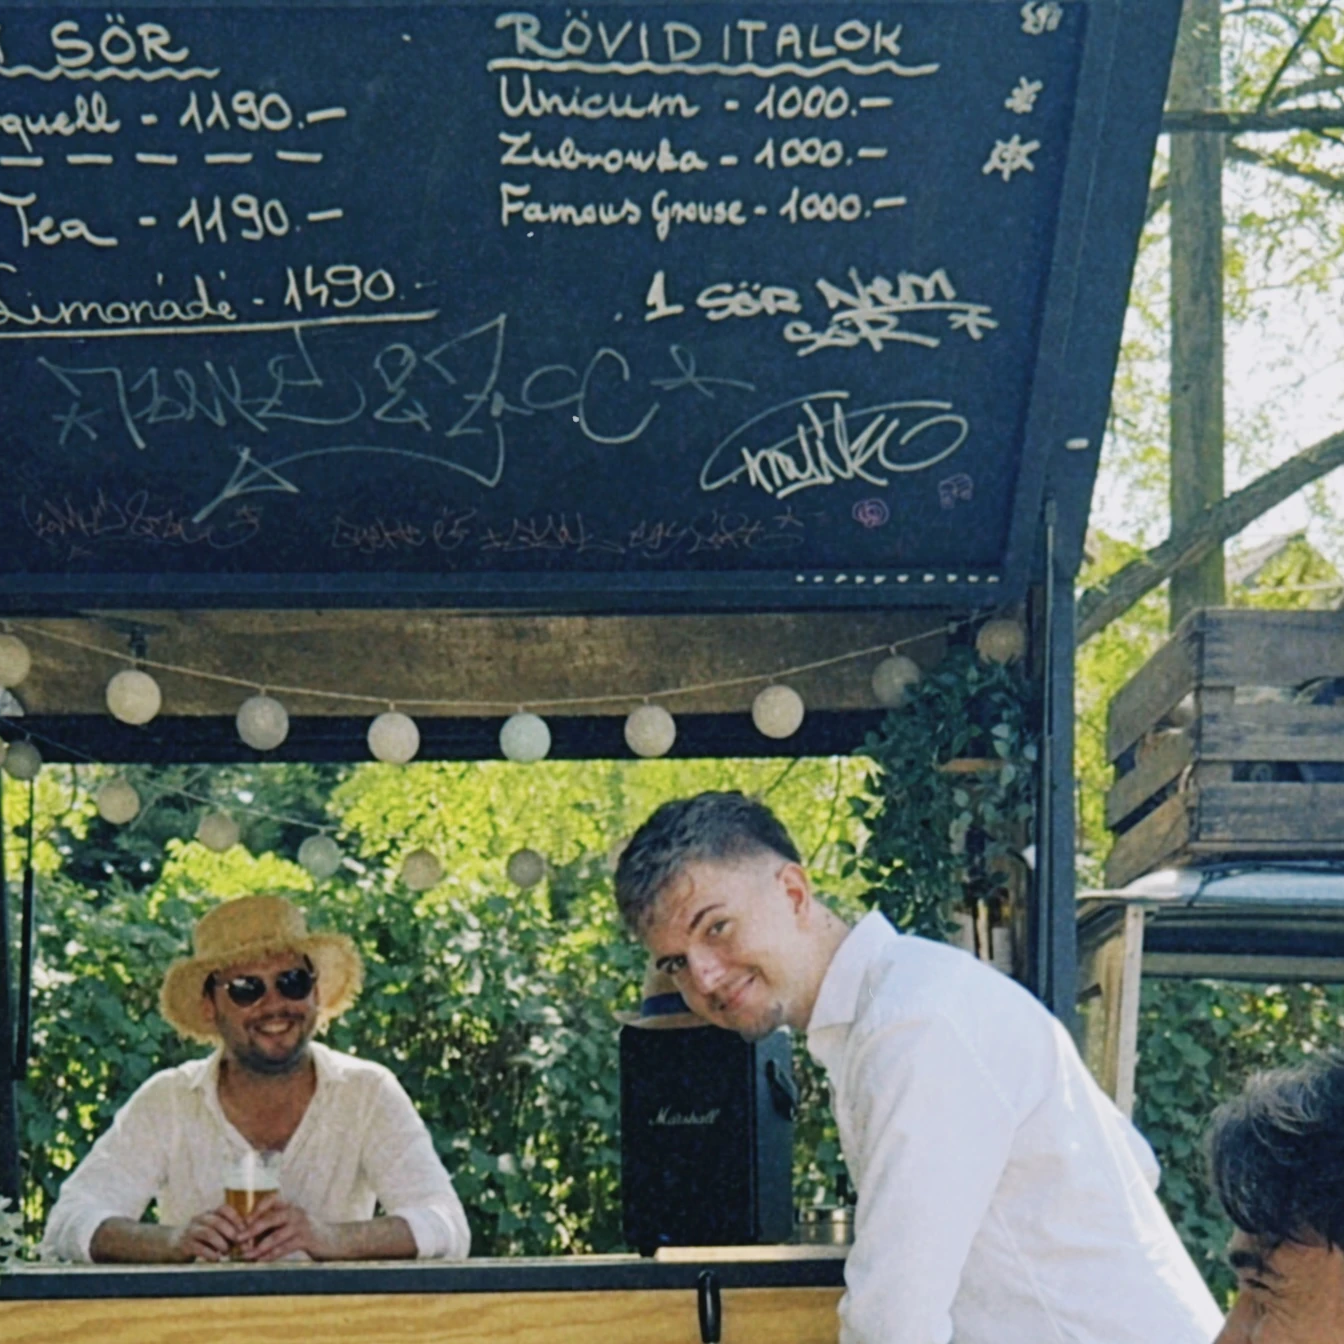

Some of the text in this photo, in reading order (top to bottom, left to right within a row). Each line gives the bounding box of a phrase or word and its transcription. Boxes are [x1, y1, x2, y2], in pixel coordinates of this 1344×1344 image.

[50, 13, 189, 69] SÖR
[493, 9, 902, 63] RÖVID ITALOK
[500, 71, 702, 119] Unicum
[498, 131, 708, 173] Zubrowka
[500, 182, 642, 226] Famous
[651, 189, 747, 241] Grouse
[645, 270, 684, 321] 1
[648, 1104, 720, 1126] Marshall
